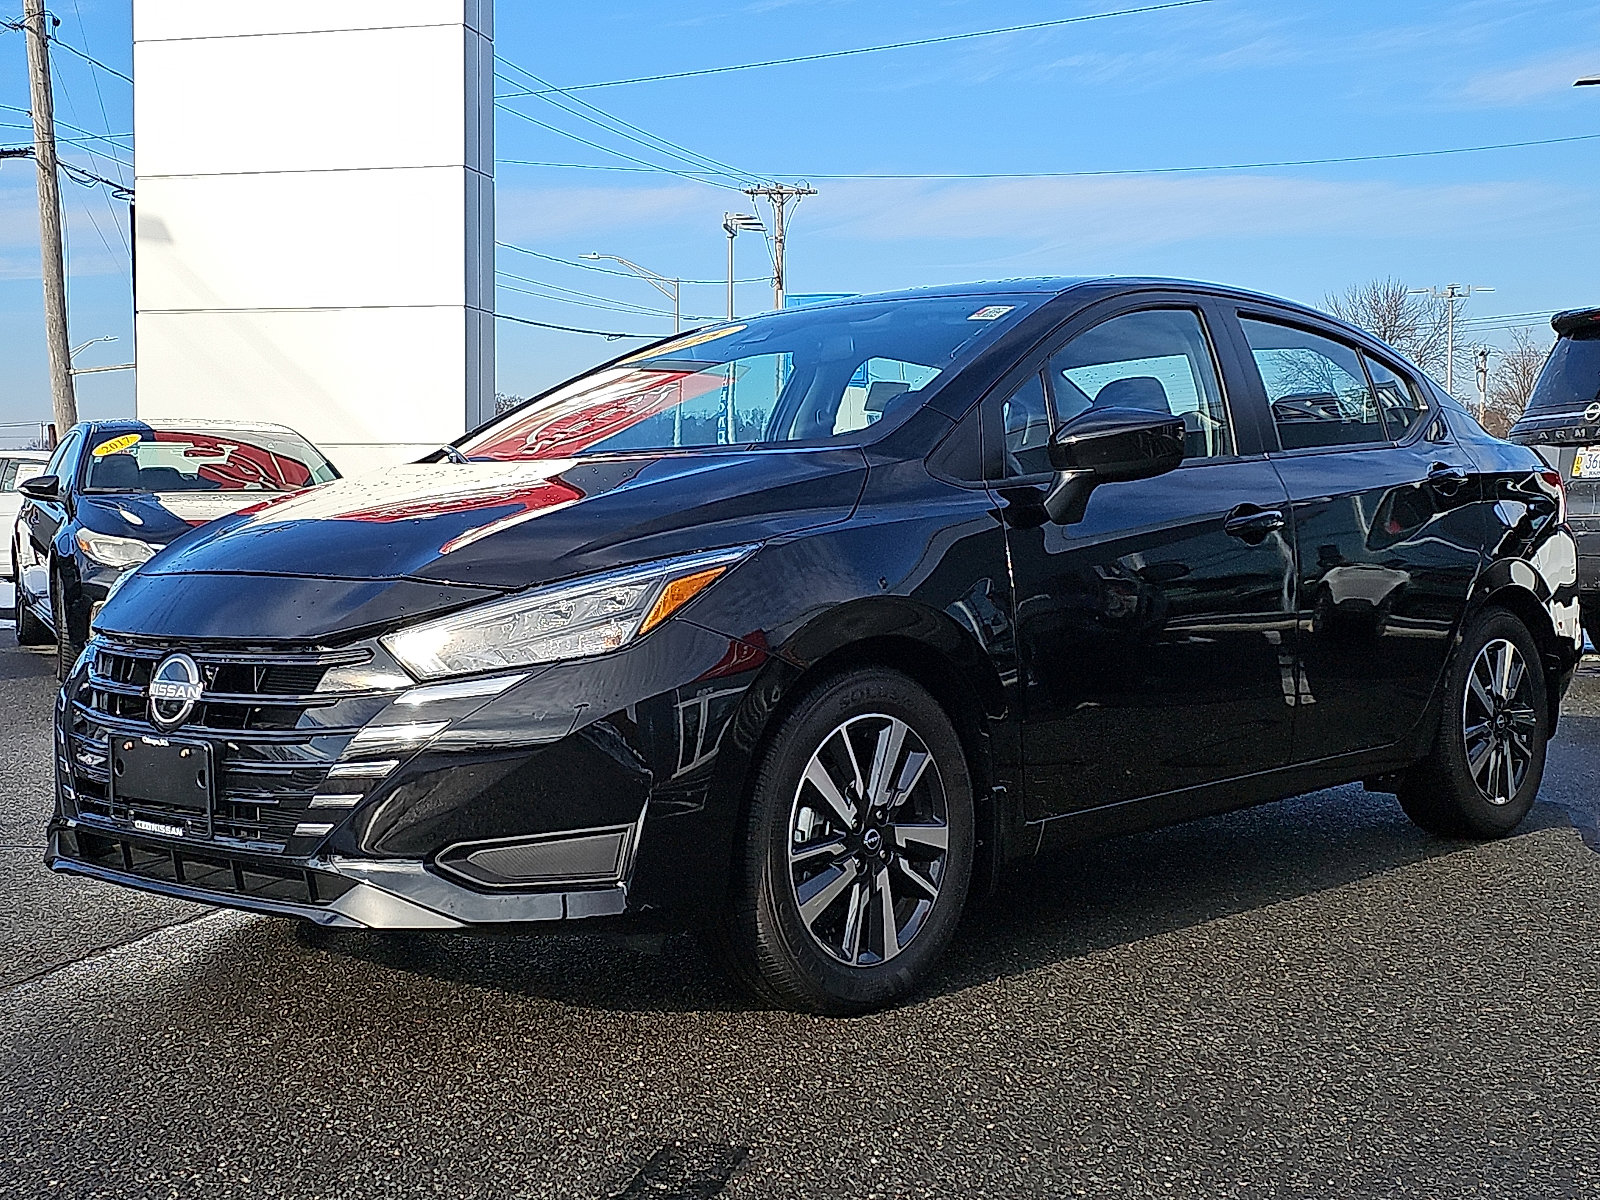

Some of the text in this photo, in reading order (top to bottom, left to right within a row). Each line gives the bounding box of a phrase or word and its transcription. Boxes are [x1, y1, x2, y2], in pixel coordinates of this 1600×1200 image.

[102, 437, 130, 453] 2017
[1586, 453, 1600, 470] 36
[150, 683, 200, 699] NISSAN
